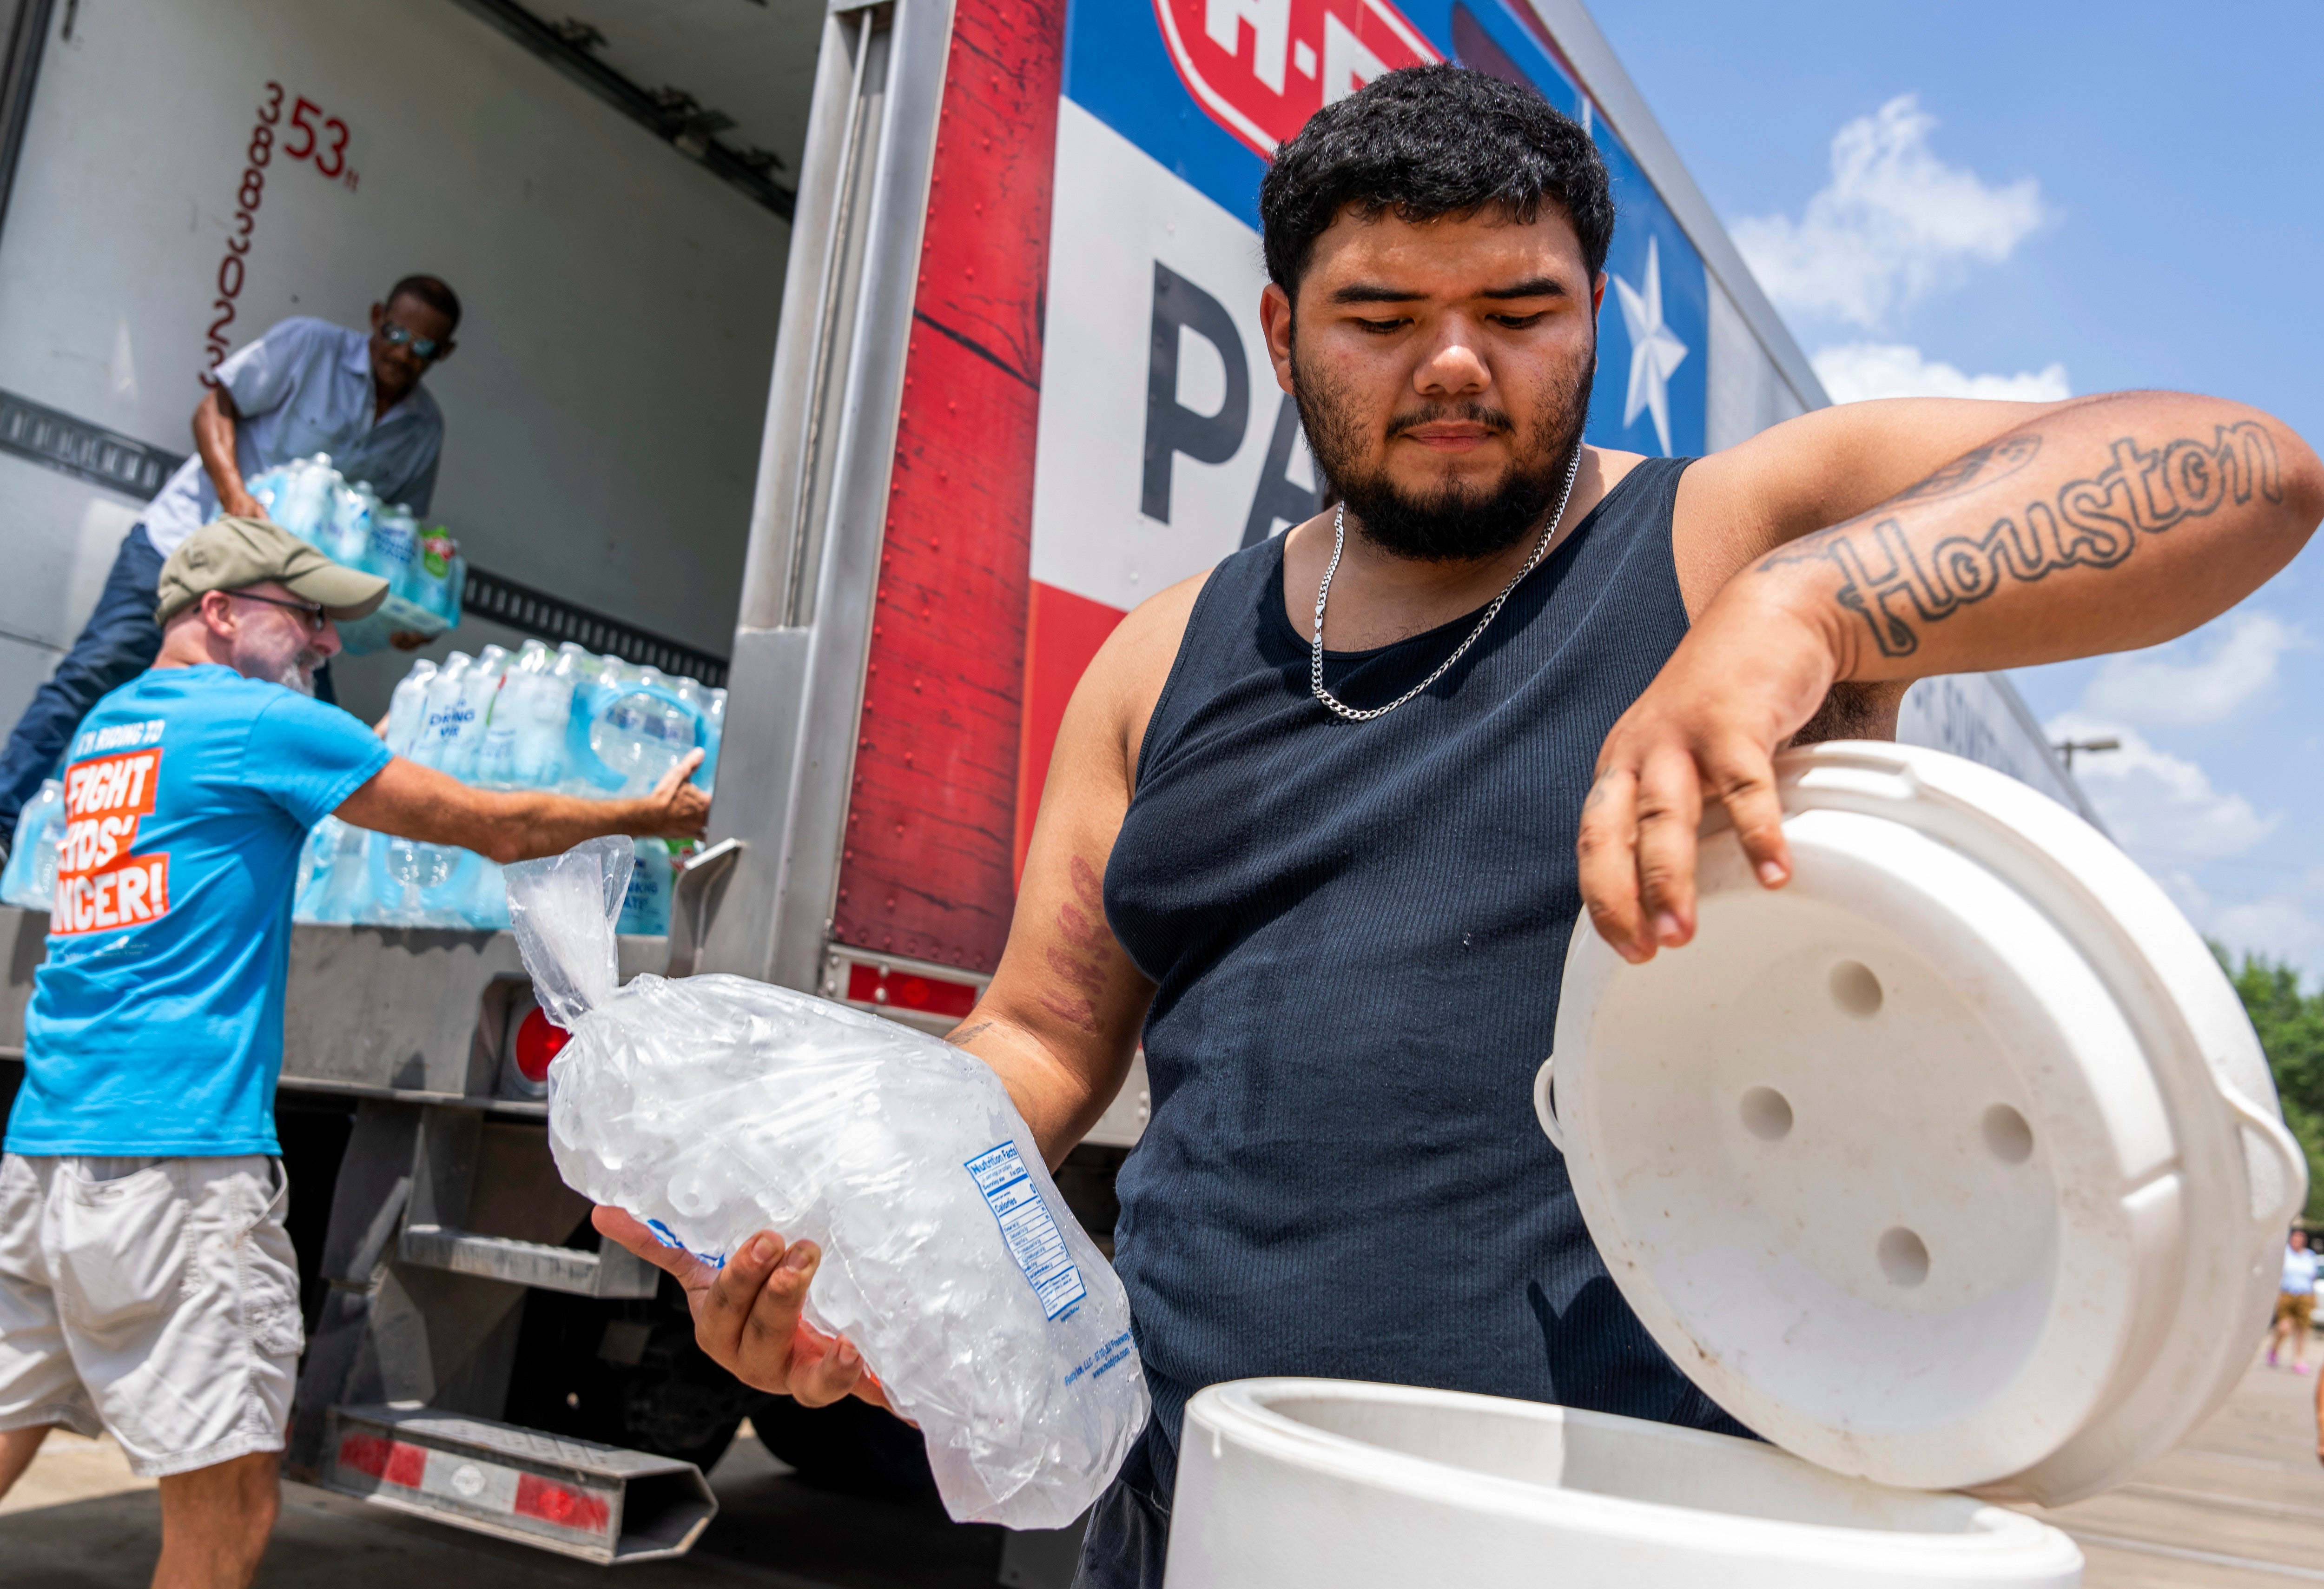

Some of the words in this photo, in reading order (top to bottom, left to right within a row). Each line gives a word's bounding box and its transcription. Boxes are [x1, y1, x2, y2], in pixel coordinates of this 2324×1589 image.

[284, 96, 350, 179] 53
[1828, 420, 2283, 658] Houston
[68, 755, 155, 819] FIGHT
[971, 1154, 1004, 1175] Nutrition
[1001, 1147, 1017, 1160] Facts
[995, 1197, 1017, 1213] Calories
[1083, 1357, 1093, 1371] LLC
[1110, 1331, 1131, 1349] Freeway,
